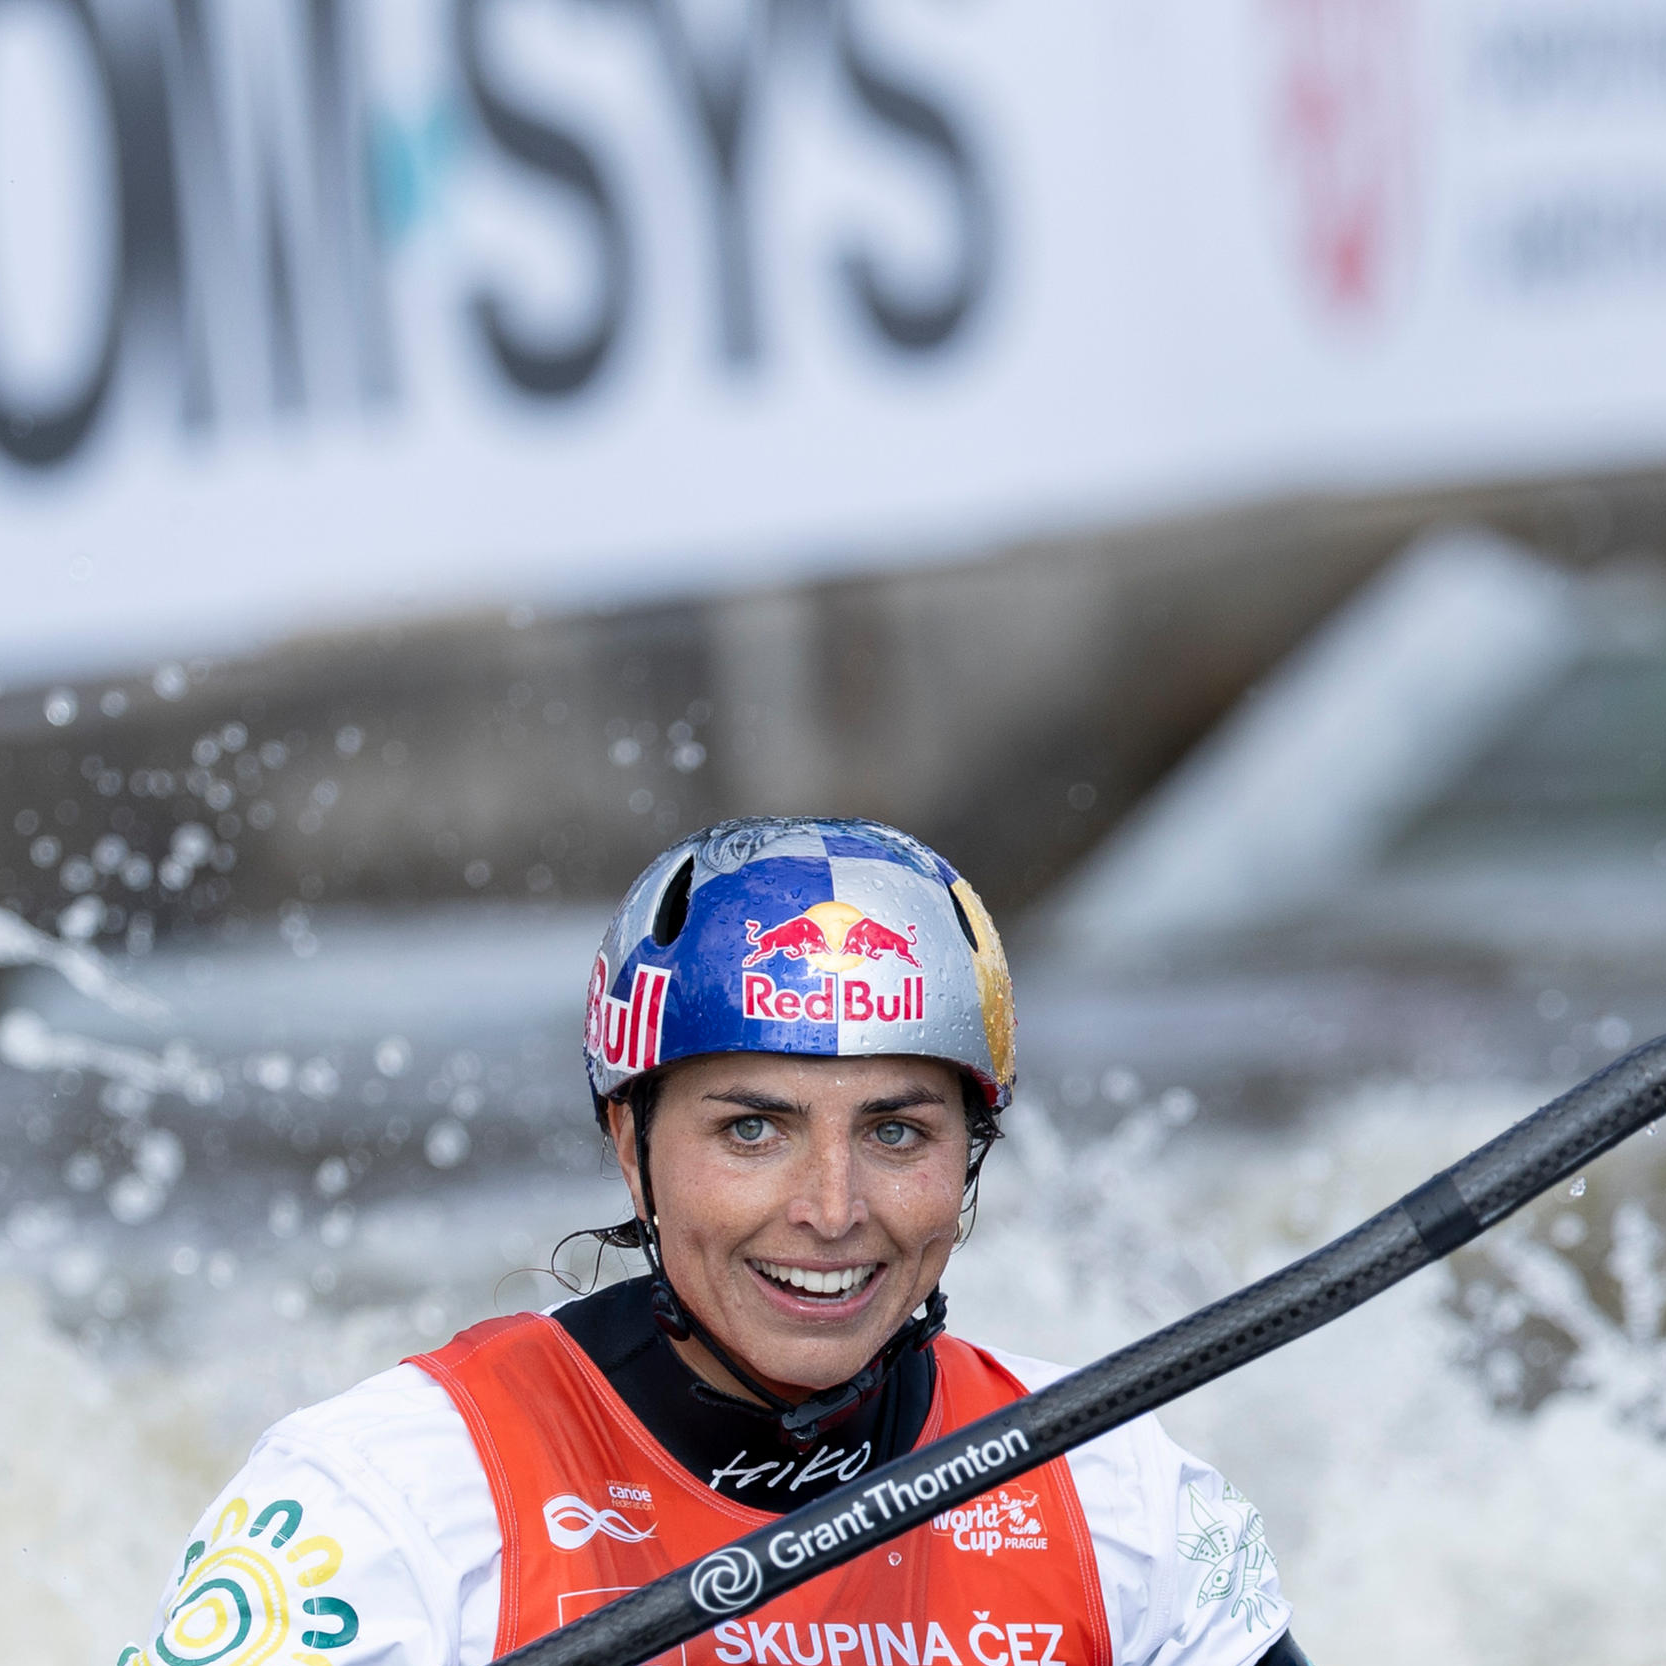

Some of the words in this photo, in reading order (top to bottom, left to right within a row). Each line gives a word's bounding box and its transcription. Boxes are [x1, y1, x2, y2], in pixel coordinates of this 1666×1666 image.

[744, 973, 834, 1022] Red
[843, 975, 925, 1023] Bull
[607, 1485, 653, 1503] canoe
[766, 1500, 876, 1570] Grant
[862, 1428, 1031, 1521] Thornton
[953, 1523, 1003, 1557] Cup
[1004, 1537, 1048, 1550] PRAGUE
